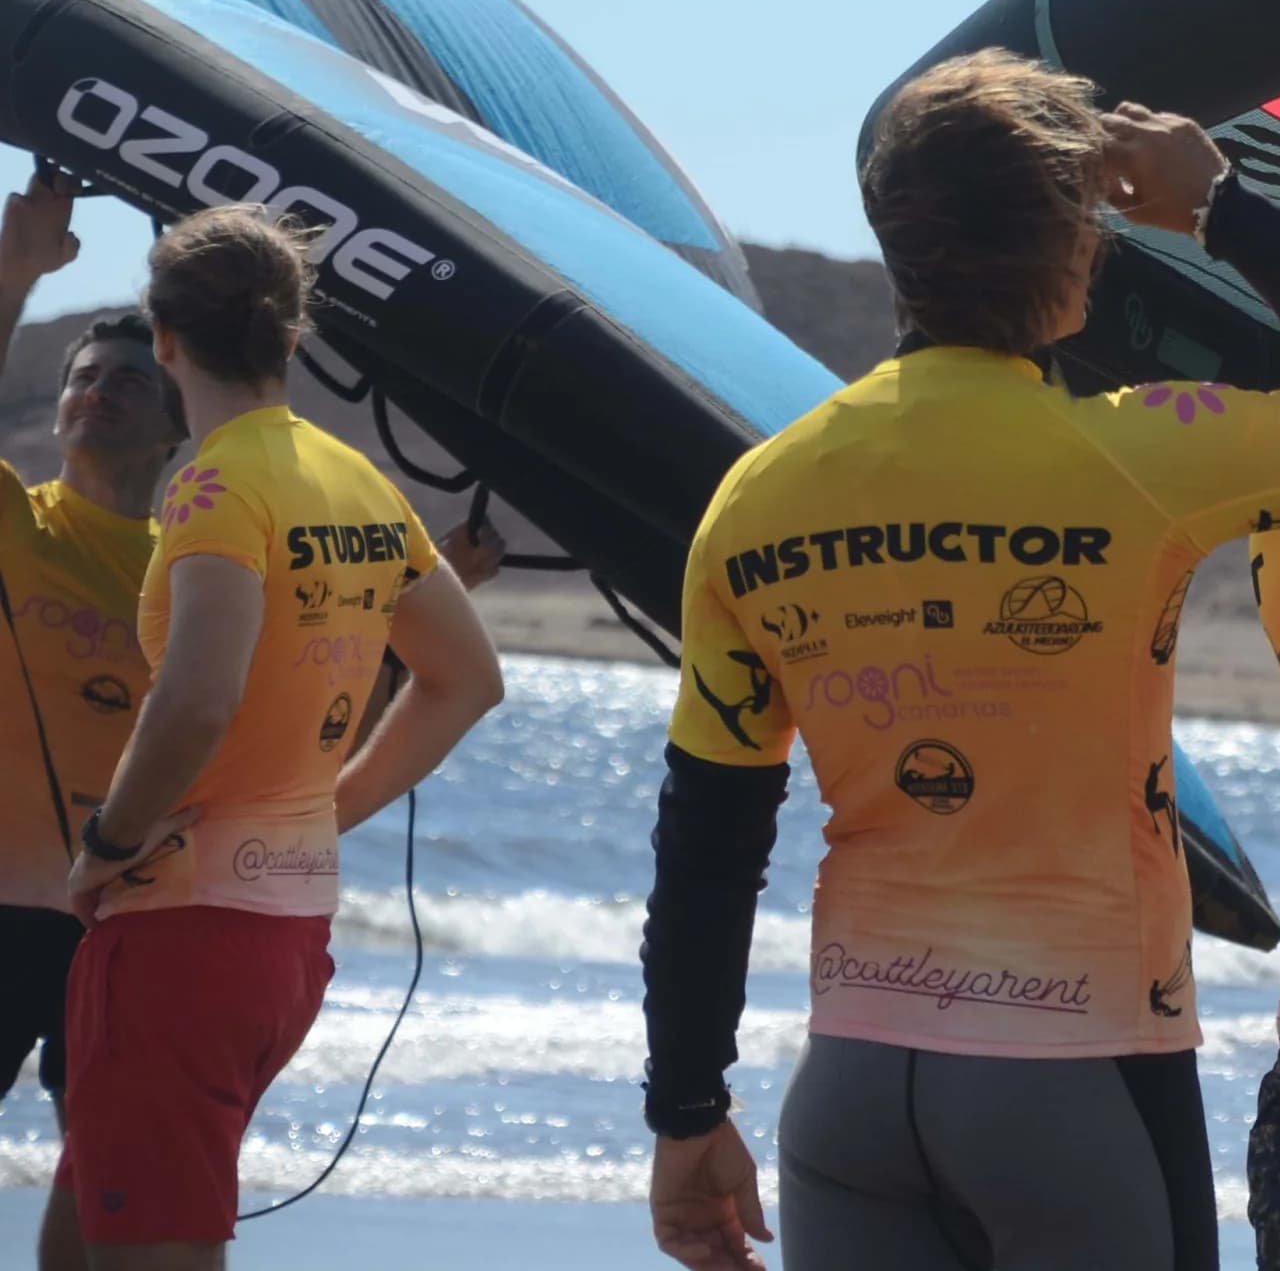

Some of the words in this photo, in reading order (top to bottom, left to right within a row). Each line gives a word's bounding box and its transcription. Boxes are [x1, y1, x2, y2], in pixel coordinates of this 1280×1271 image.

[725, 522, 1112, 599] INSTRUCTOR
[844, 607, 917, 629] Eleveight
[804, 652, 953, 731] sogni
[898, 701, 1015, 721] canarias
[814, 941, 1091, 1011] @cattleyarent
